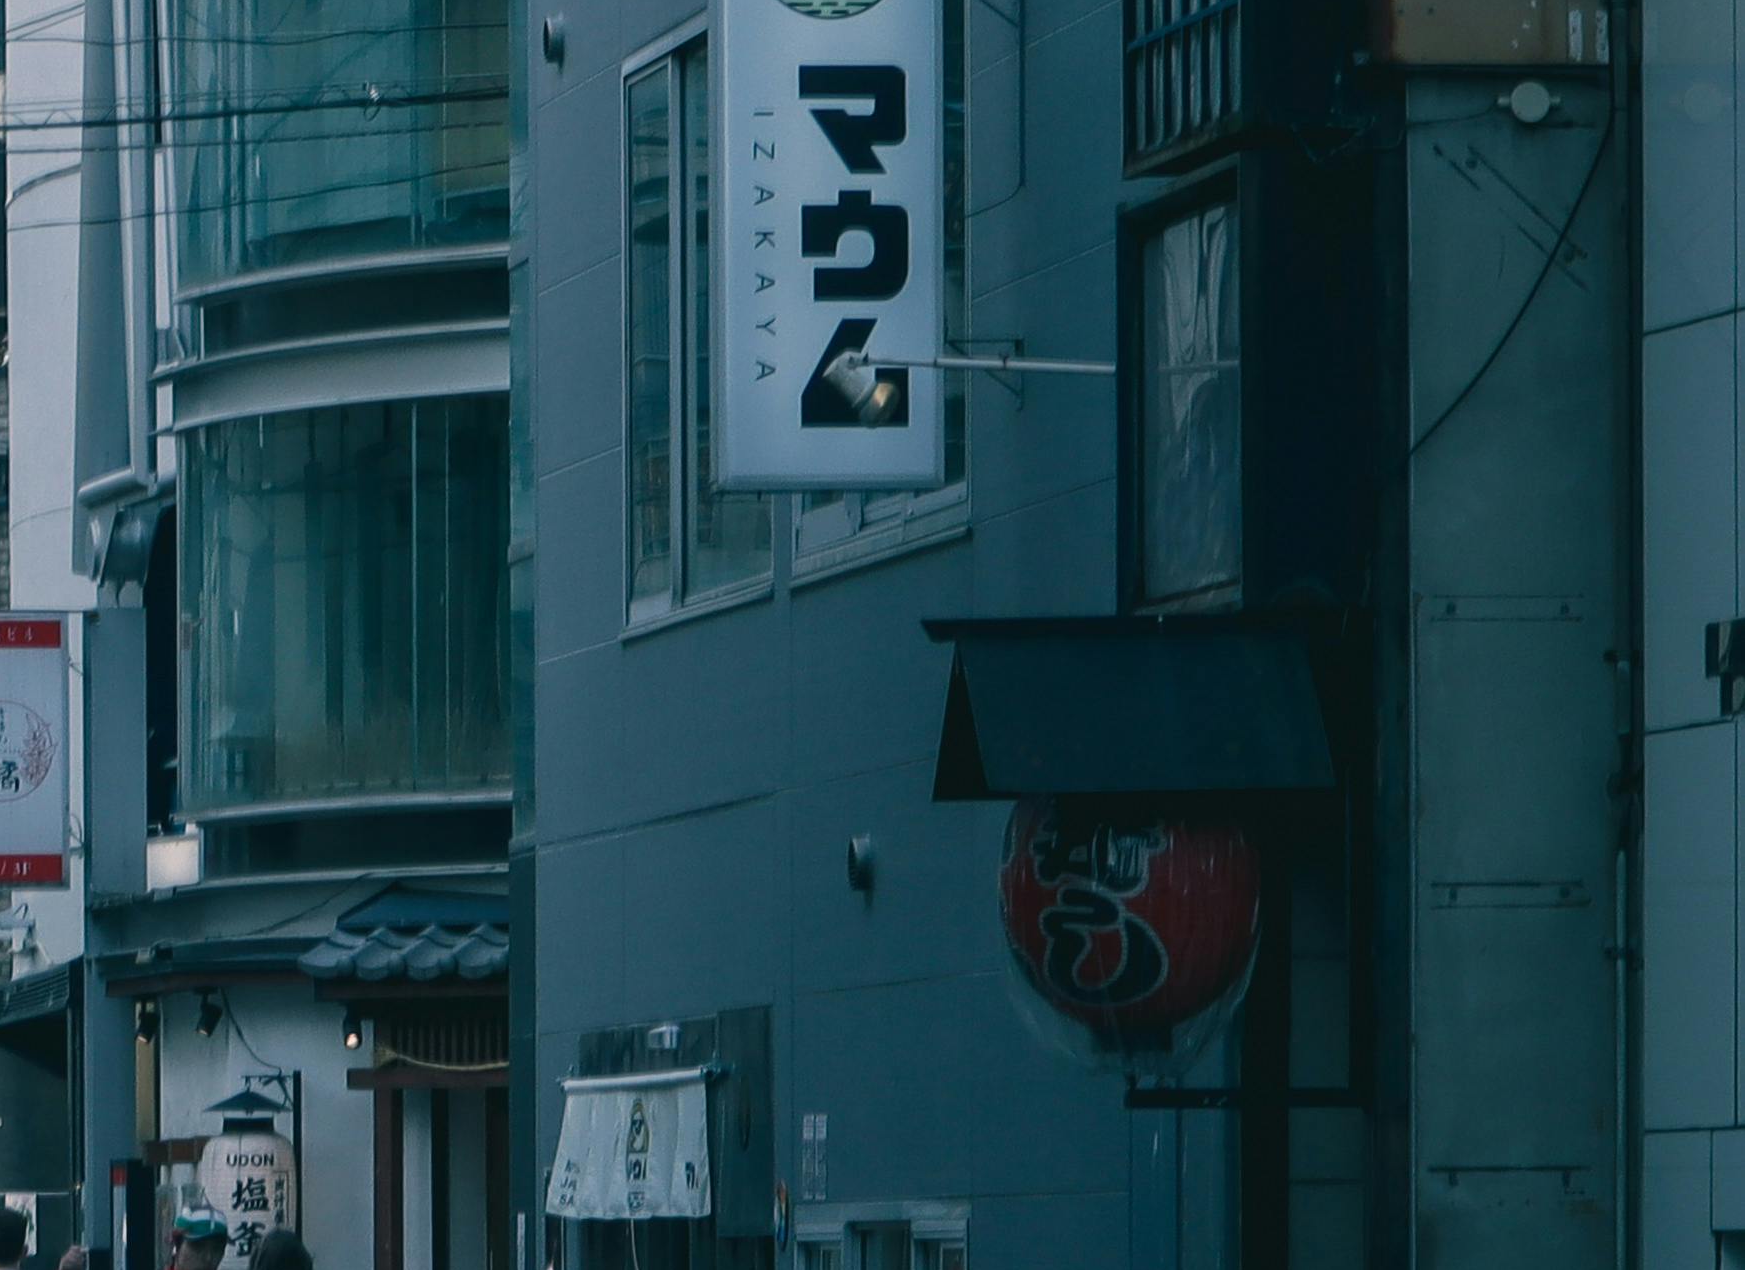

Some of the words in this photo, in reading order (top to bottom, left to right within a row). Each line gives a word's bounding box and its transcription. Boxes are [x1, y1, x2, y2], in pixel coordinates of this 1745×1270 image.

[752, 109, 776, 383] IZAKAYA
[797, 64, 911, 430] マウム
[226, 1154, 274, 1167] UDON
